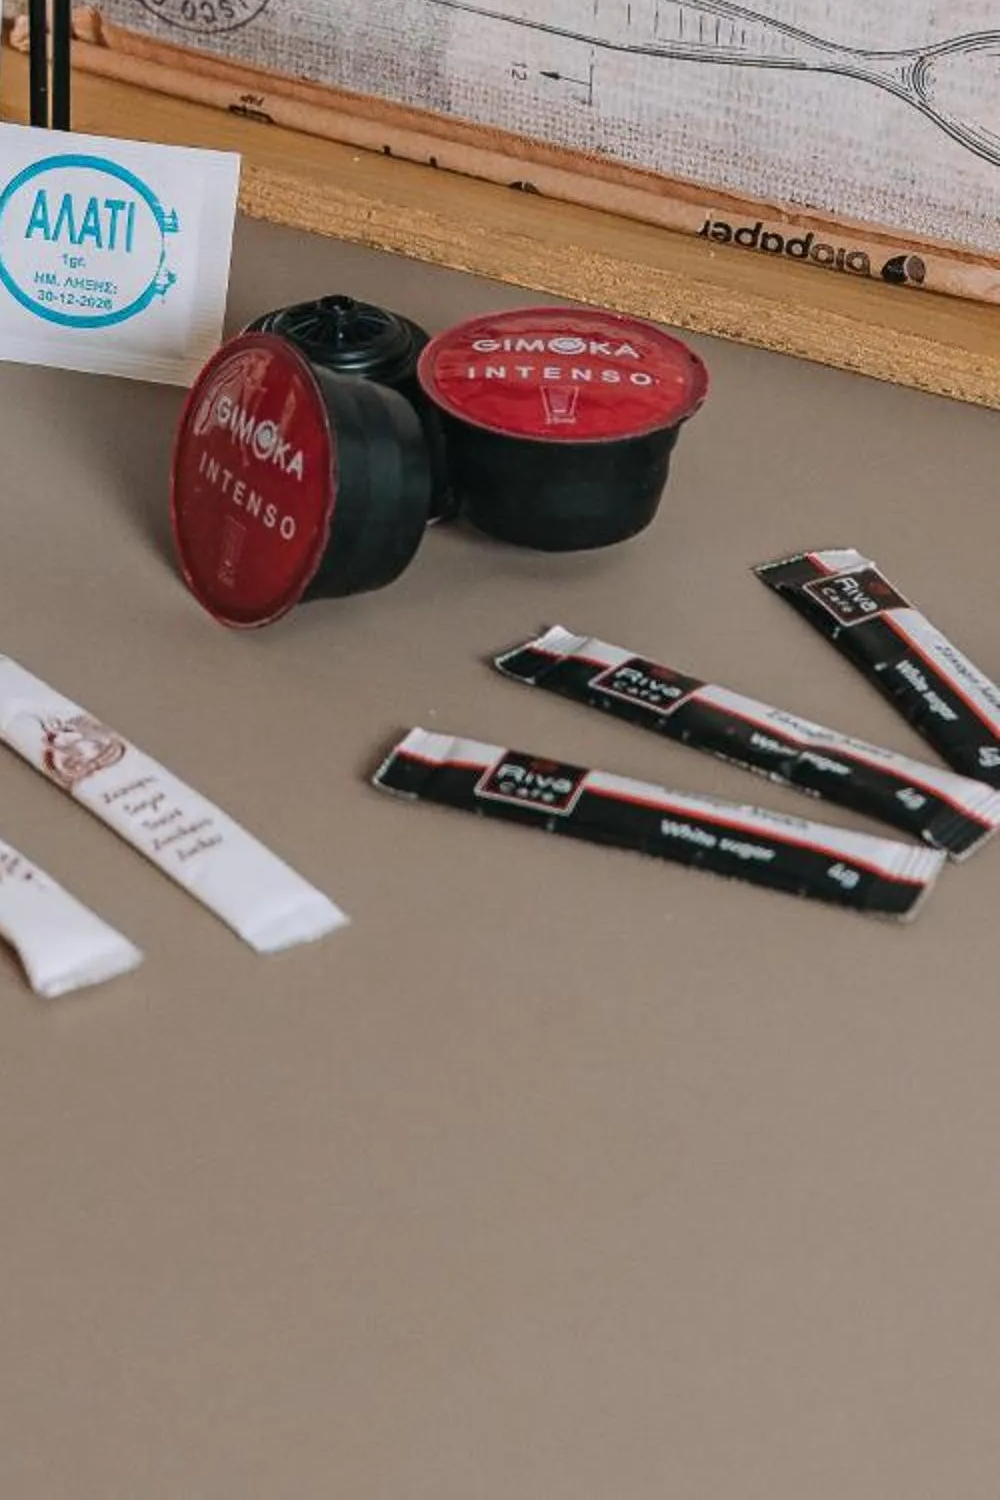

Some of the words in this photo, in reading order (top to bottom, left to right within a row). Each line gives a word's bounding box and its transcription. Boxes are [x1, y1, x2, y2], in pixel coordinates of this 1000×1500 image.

[509, 61, 529, 82] 12
[23, 188, 137, 254] ΑΛΑΤΙ
[472, 336, 641, 360] GIMOKA
[467, 365, 653, 386] INTENSO
[214, 394, 305, 482] GIMOKA
[197, 450, 297, 541] INTENSO
[833, 577, 878, 613] Riva
[615, 667, 682, 698] Riva
[497, 763, 572, 794] Riva
